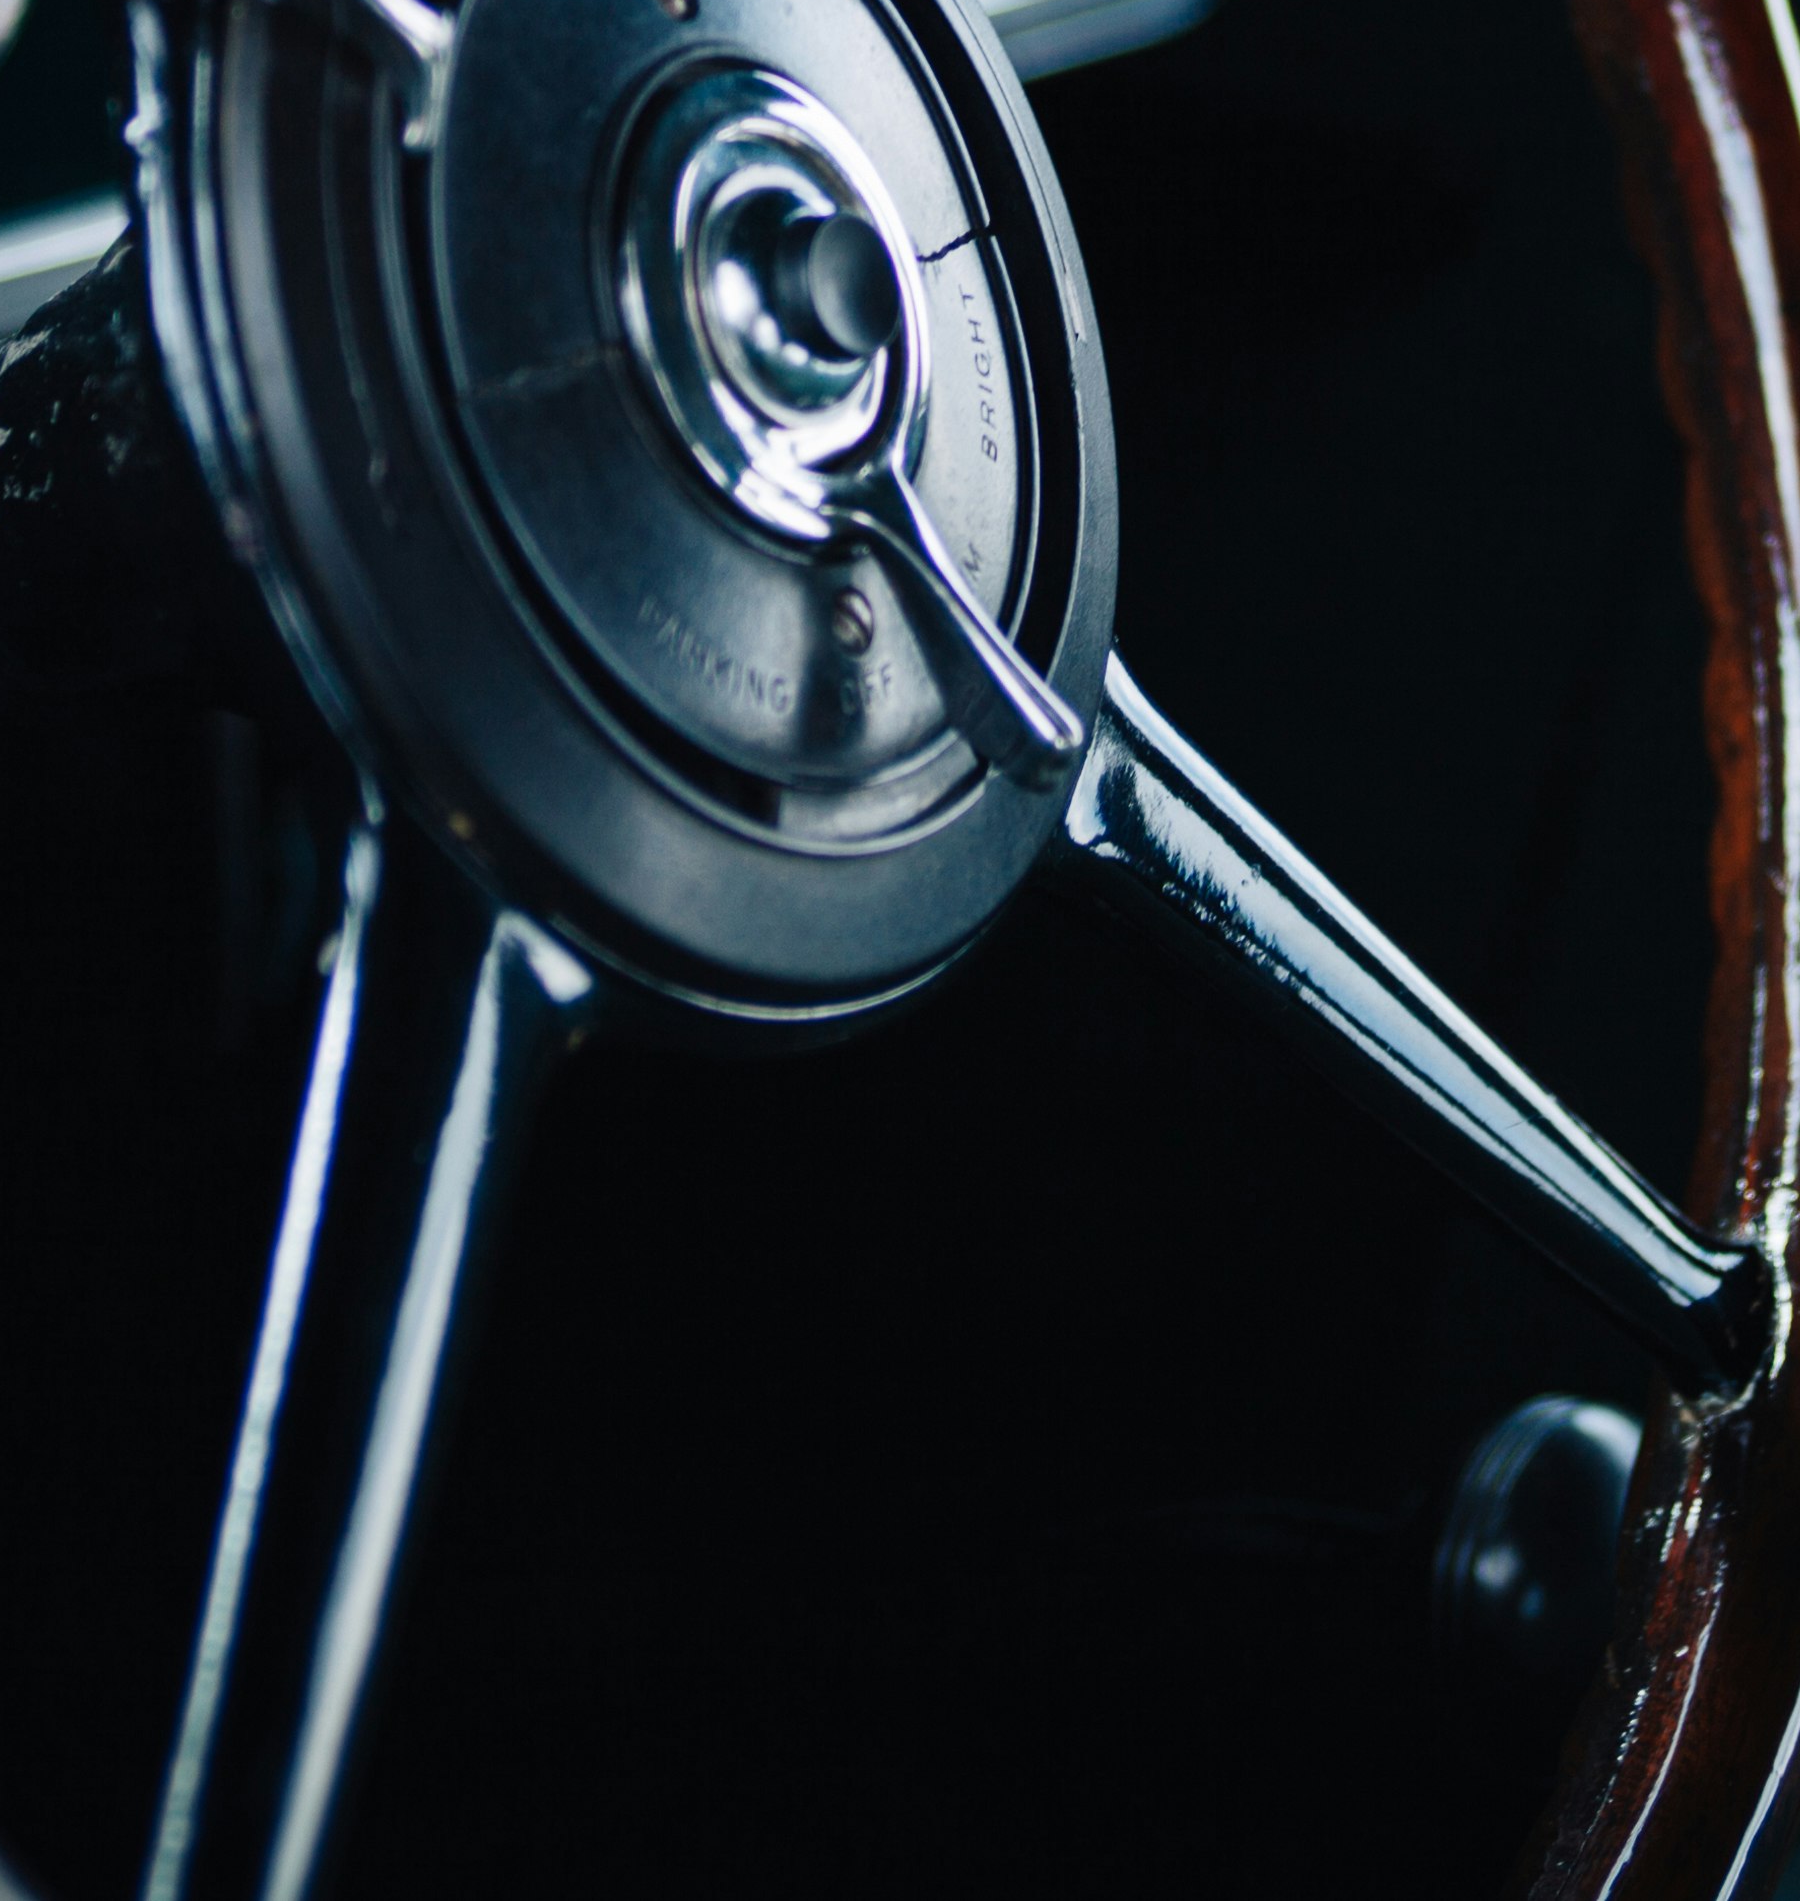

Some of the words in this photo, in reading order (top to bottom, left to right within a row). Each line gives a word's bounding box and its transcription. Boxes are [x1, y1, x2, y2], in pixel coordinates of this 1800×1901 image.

[960, 290, 998, 462] BRIGHT
[638, 597, 791, 714] PARKING
[839, 663, 892, 718] OFF
